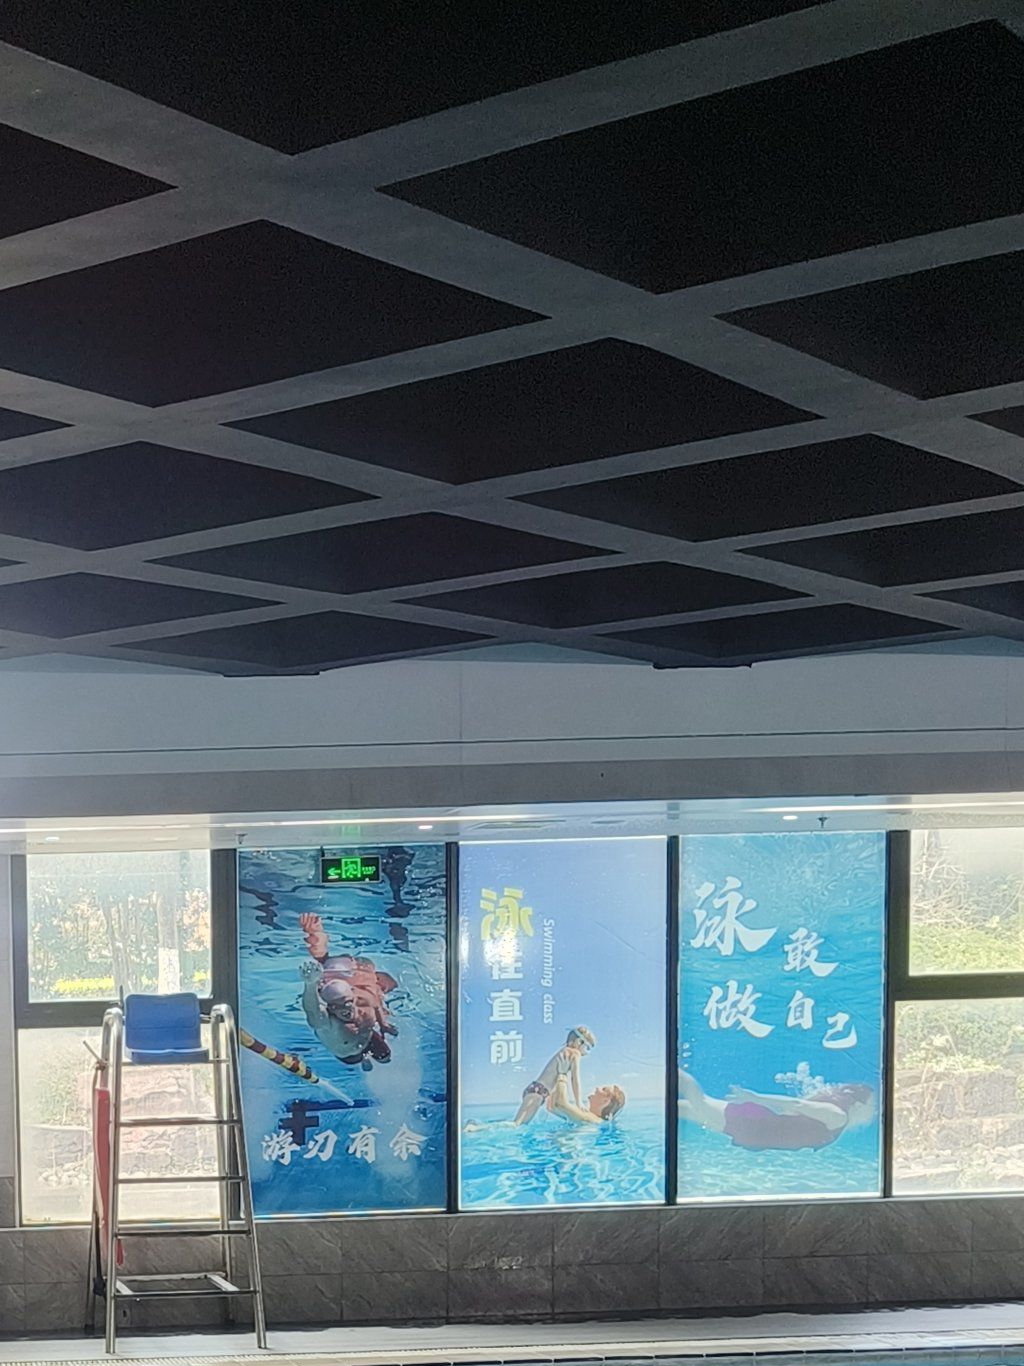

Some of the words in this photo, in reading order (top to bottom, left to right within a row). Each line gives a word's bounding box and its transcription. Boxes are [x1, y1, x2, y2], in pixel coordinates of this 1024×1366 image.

[541, 918, 555, 987] Swimming
[690, 876, 838, 977] 泳敢
[543, 993, 555, 1024] class
[703, 980, 858, 1050] 做自己
[261, 1123, 428, 1166] 游刃有余
